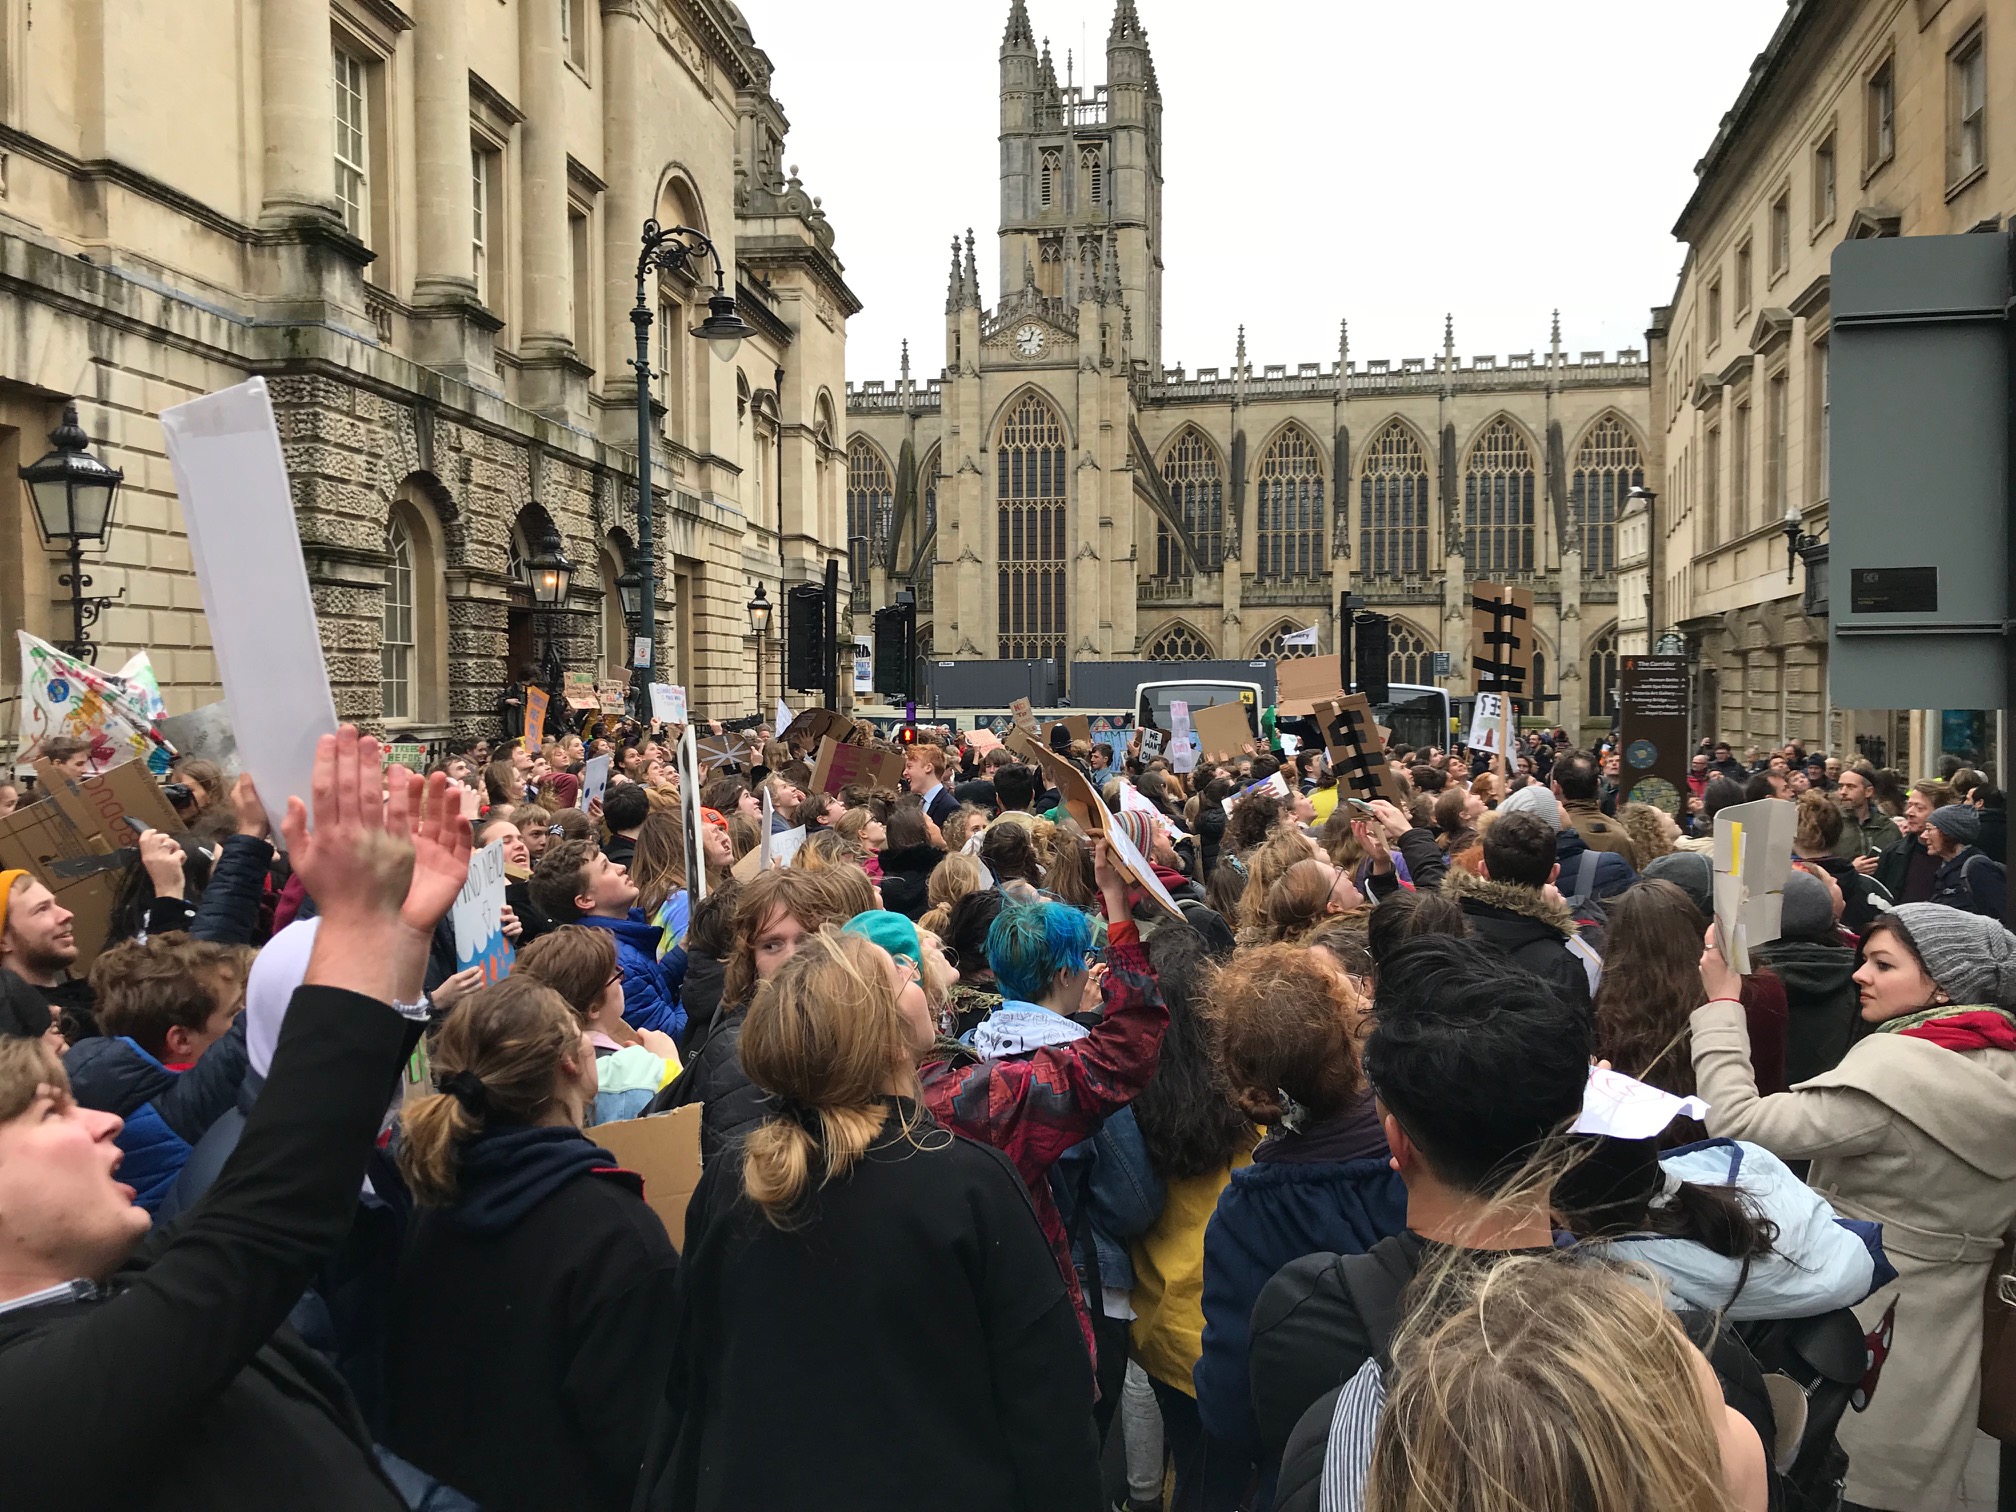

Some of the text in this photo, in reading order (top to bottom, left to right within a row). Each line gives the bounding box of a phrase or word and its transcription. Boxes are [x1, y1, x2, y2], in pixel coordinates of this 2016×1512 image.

[1149, 731, 1158, 741] WE
[1145, 740, 1162, 752] WANT
[456, 863, 481, 907] IND
